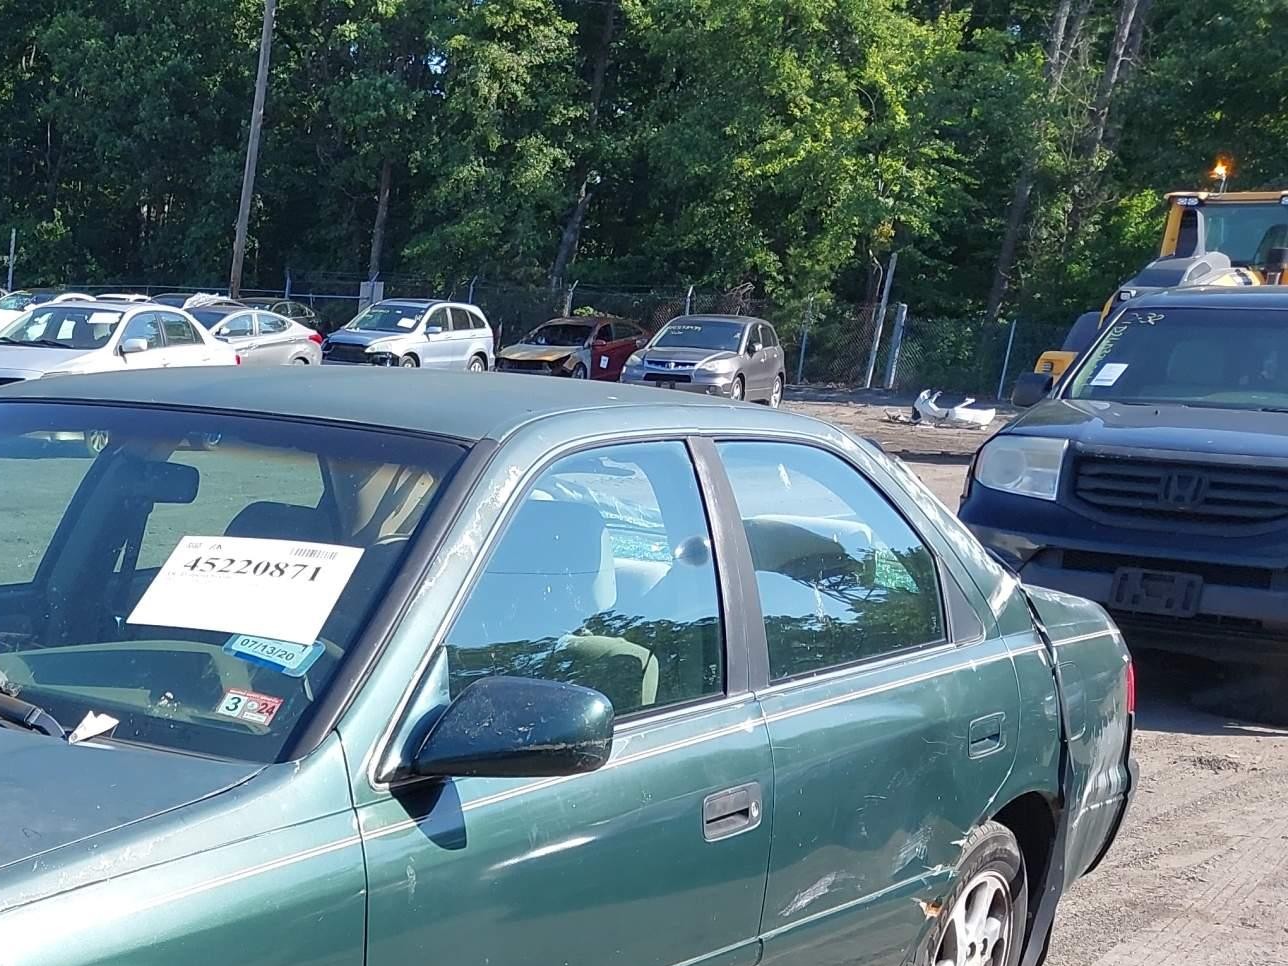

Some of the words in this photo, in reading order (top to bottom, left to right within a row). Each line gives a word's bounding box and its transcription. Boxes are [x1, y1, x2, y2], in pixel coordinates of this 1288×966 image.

[183, 556, 322, 582] 45220871
[240, 638, 295, 661] 07/13/20
[225, 696, 242, 712] 3
[258, 702, 276, 716] 24
